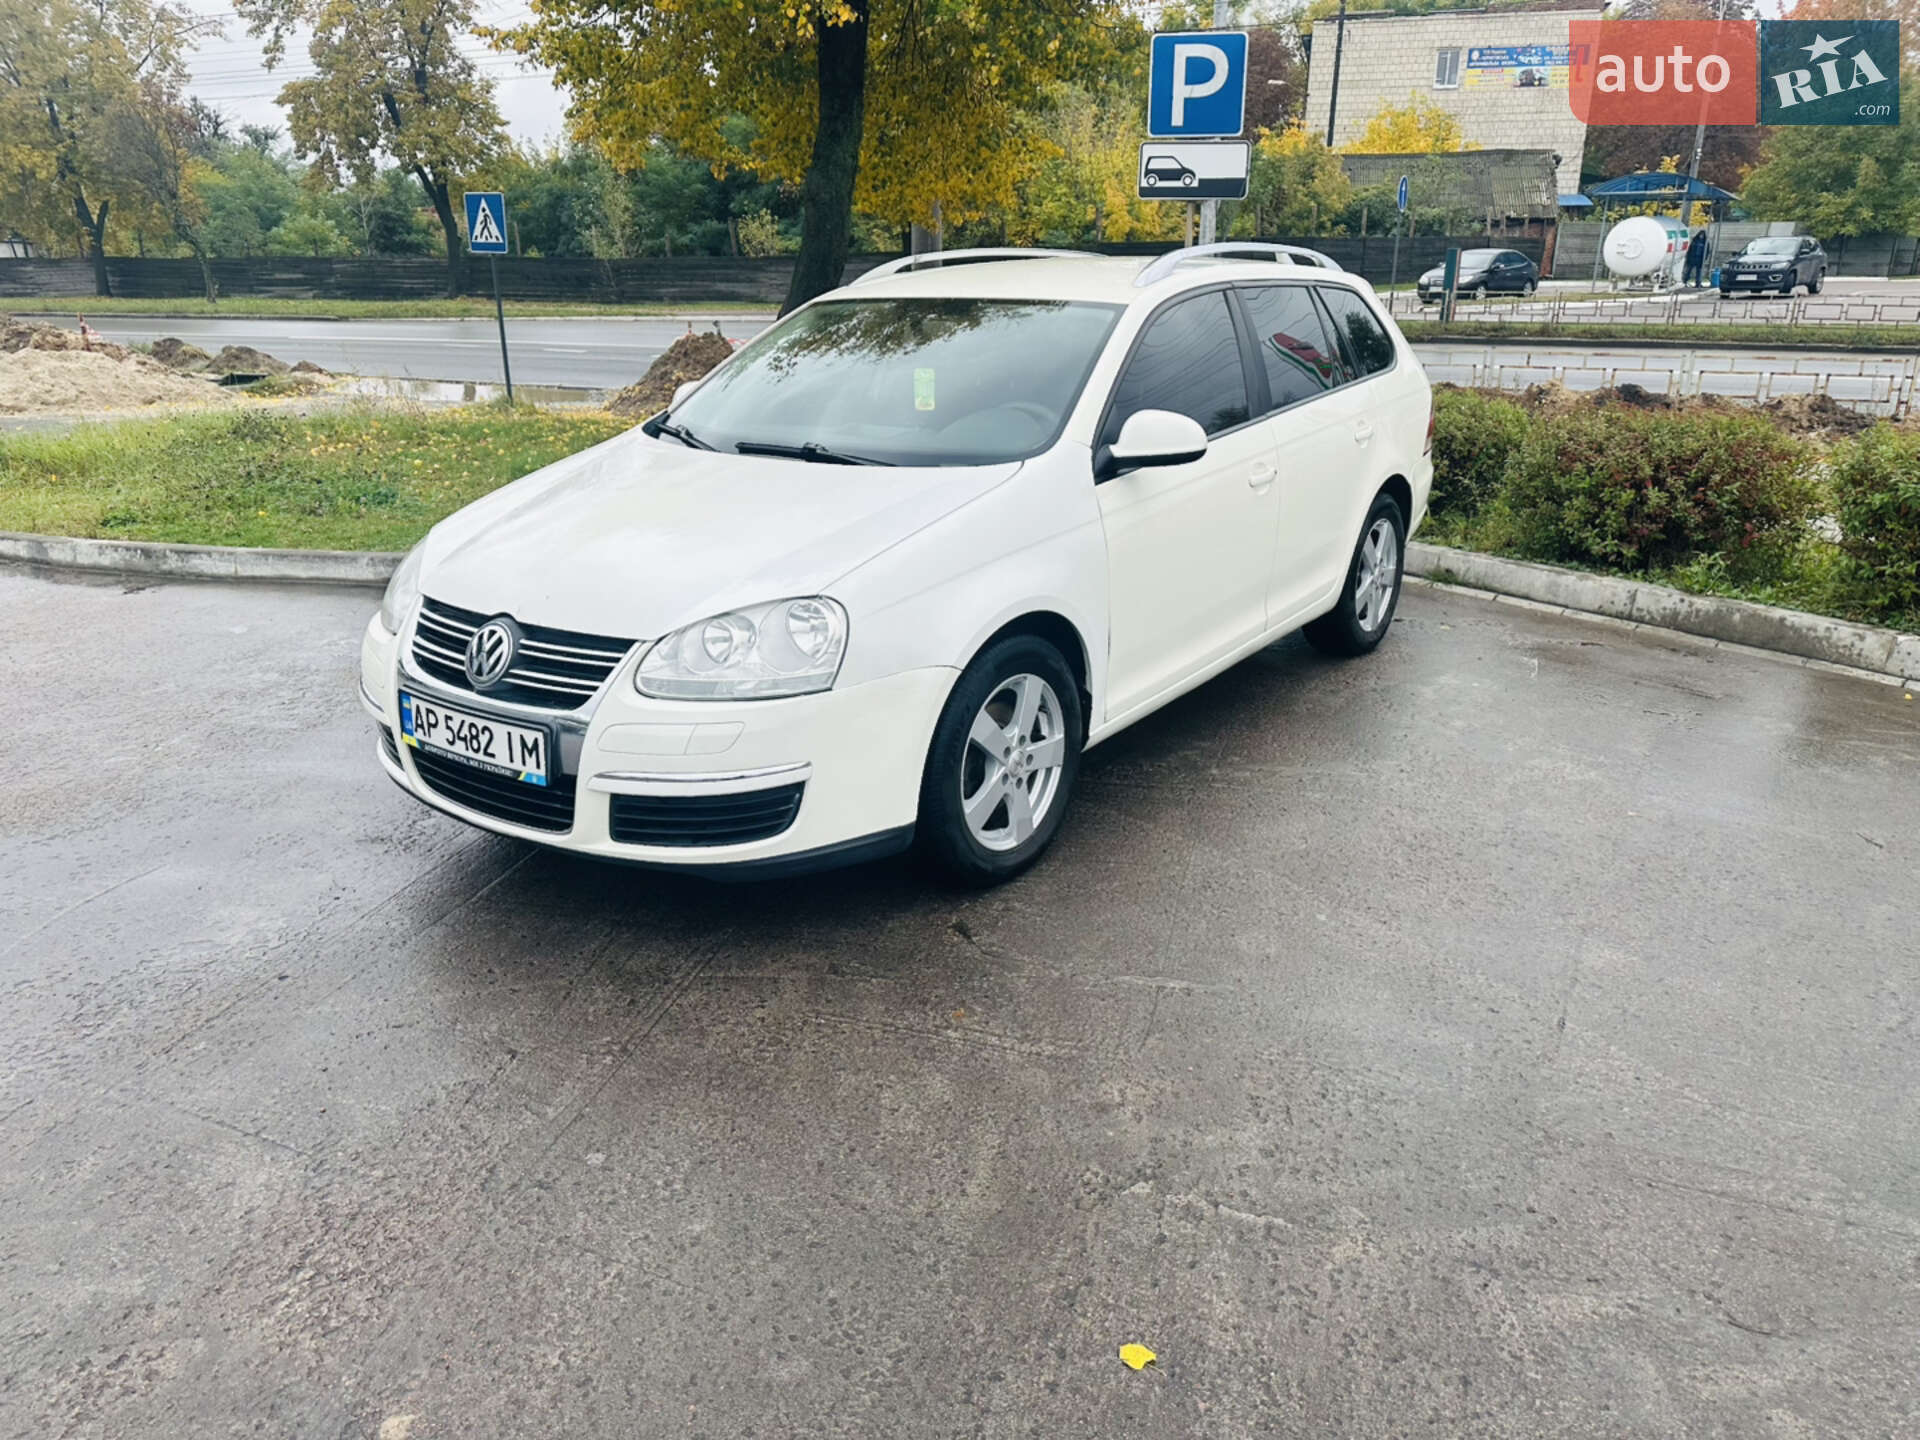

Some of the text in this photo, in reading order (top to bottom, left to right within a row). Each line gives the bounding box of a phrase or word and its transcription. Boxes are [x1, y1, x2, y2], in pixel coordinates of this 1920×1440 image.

[1171, 43, 1229, 127] P
[414, 703, 439, 738] AP
[445, 714, 496, 759] 5482
[507, 731, 541, 770] IM
